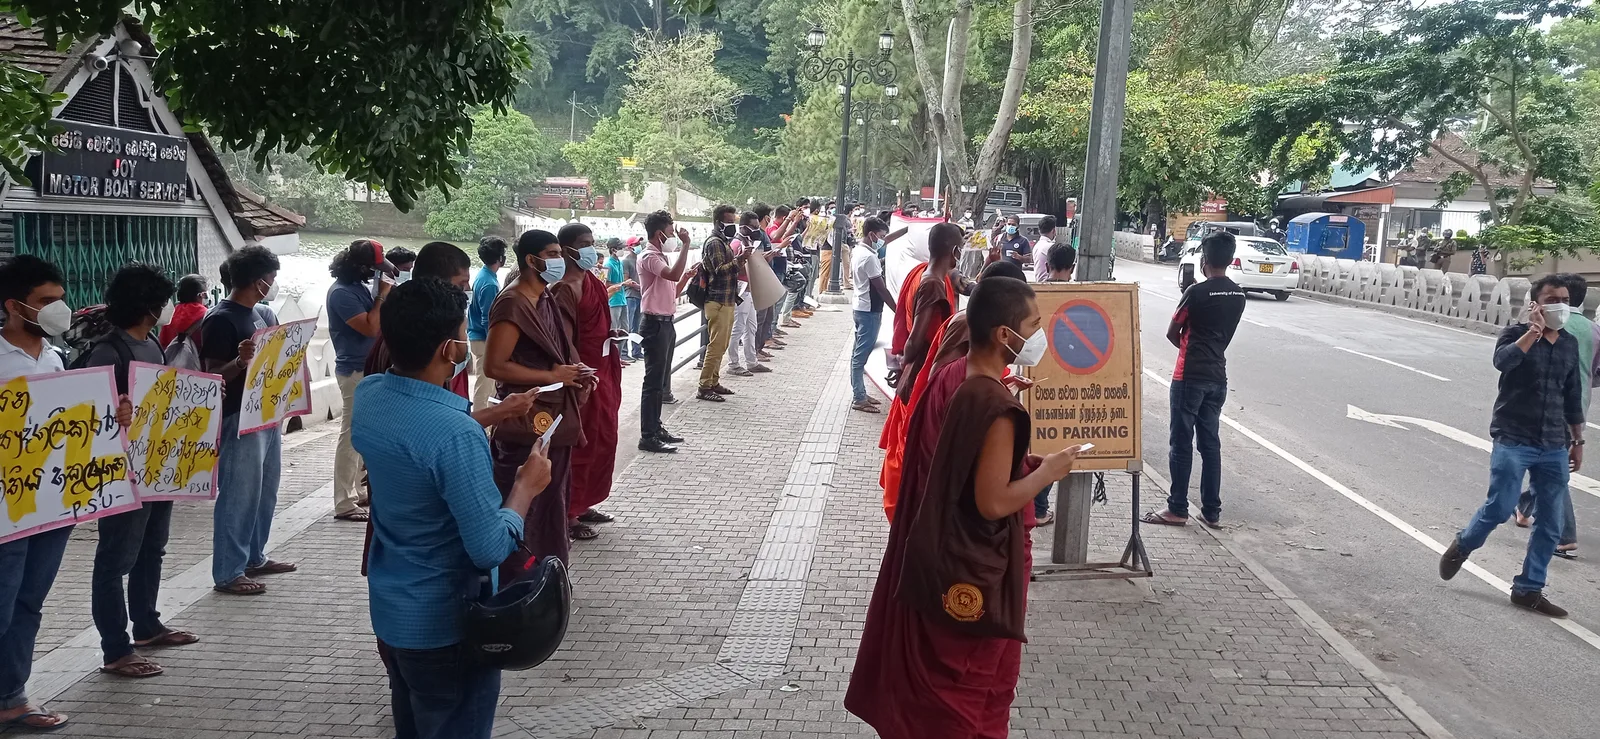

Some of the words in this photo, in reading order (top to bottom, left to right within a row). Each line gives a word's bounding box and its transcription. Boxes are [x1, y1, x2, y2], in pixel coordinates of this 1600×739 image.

[112, 158, 138, 178] JOY
[49, 173, 100, 196] MOTOR
[104, 178, 137, 198] BOAT
[139, 180, 187, 201] SERVICE
[1035, 384, 1056, 401] වාහන
[1109, 406, 1128, 423] தடை
[1036, 426, 1058, 440] NO
[1063, 425, 1129, 440] PARKING
